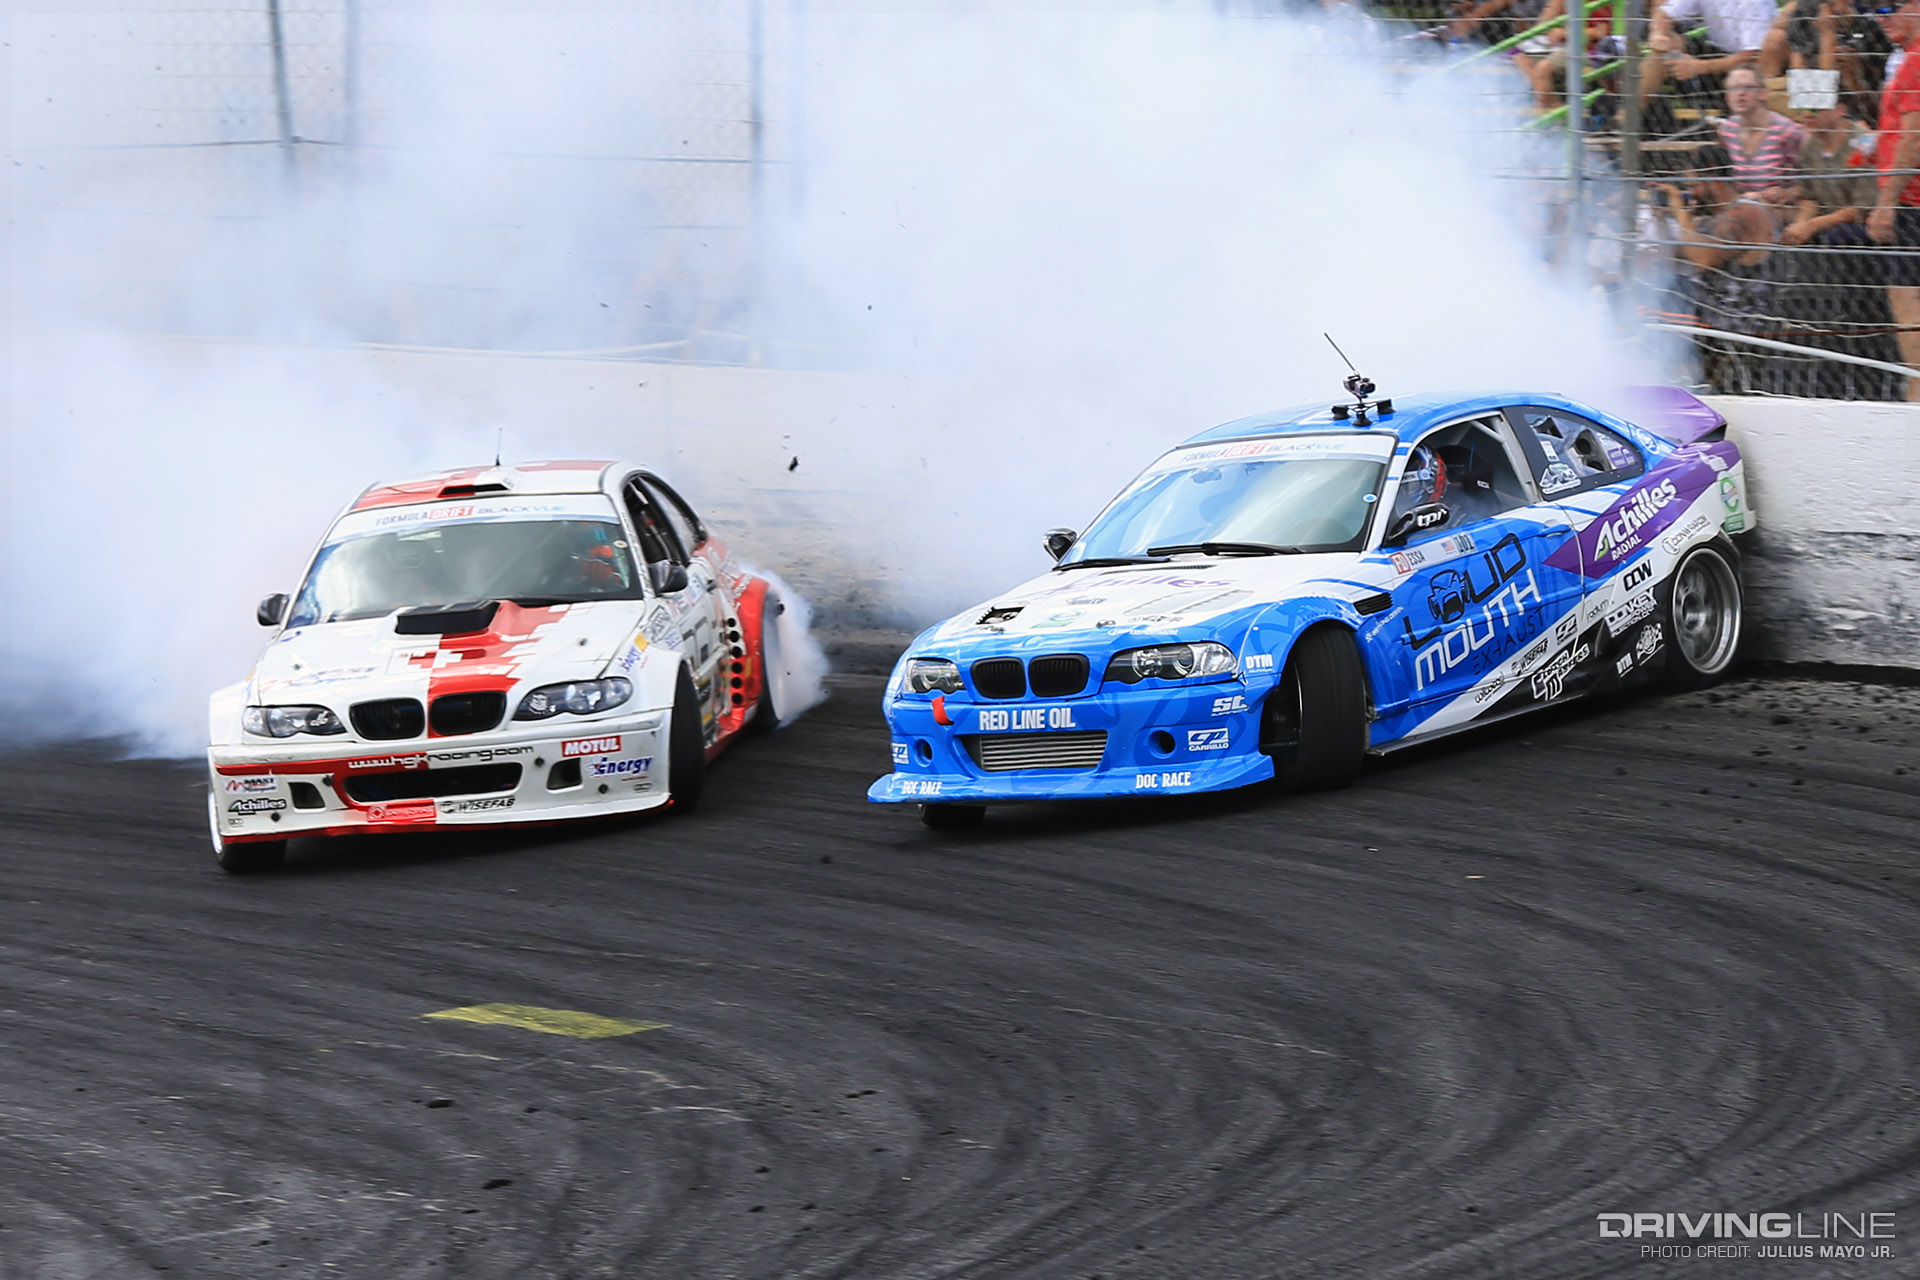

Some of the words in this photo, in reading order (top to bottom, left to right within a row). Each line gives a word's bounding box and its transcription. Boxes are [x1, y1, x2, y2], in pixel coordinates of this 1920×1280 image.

[376, 512, 428, 527] FORMULA
[430, 506, 474, 520] DRIFT
[478, 505, 565, 515] BLACKVUE
[1595, 478, 1677, 561] Achilles
[1611, 534, 1642, 561] RADIAL
[1407, 550, 1426, 566] ESSA
[1605, 587, 1658, 623] DONKEY
[1415, 568, 1542, 691] MOUTH
[1472, 607, 1547, 676] EXHAUST
[1245, 654, 1274, 669] DTM
[979, 710, 1008, 731] RED
[1012, 709, 1045, 730] LINE
[1049, 707, 1076, 729] OIL
[565, 738, 619, 756] MOTUL
[902, 781, 918, 794] DOC
[919, 781, 942, 794] RACE
[1136, 774, 1157, 788] DOC
[1162, 772, 1191, 787] RACE
[230, 799, 286, 812] Achilles
[459, 797, 515, 813] WISEFAB
